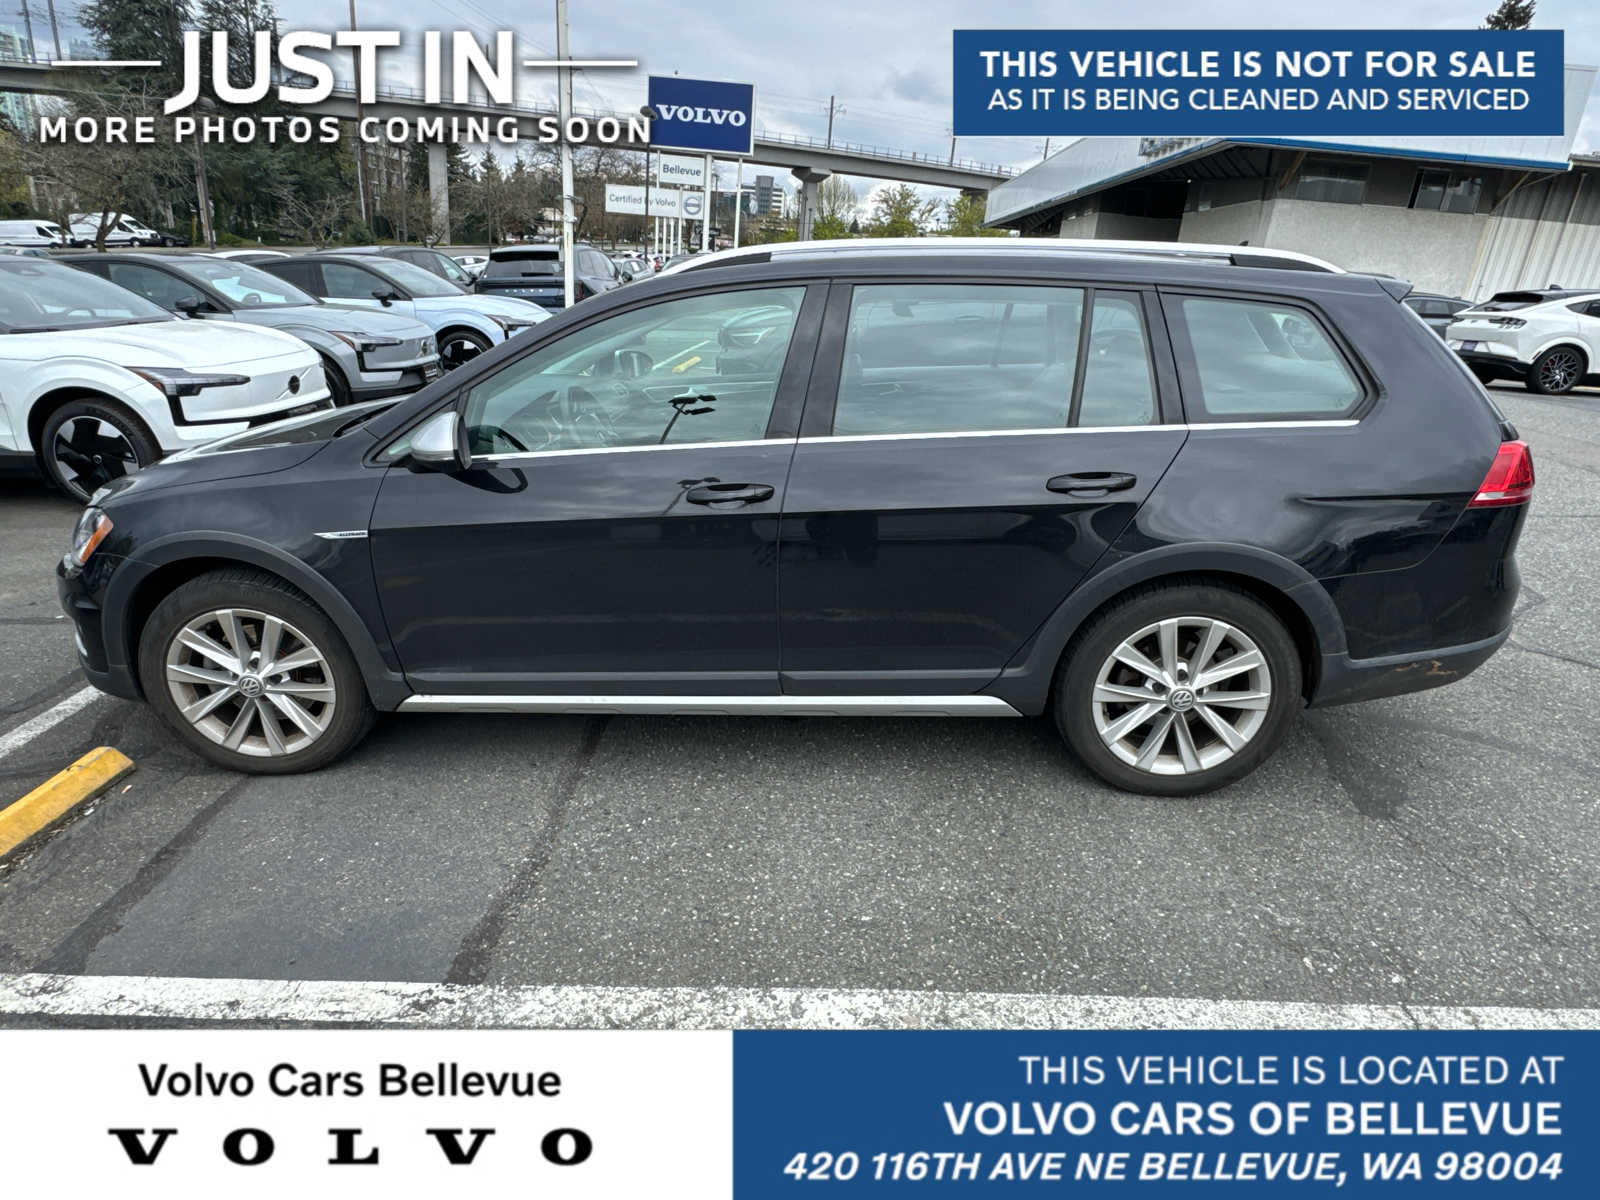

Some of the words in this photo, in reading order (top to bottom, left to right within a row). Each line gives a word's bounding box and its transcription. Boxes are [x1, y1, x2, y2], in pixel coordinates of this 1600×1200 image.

[656, 103, 746, 127] VOLVO
[662, 164, 702, 177] Bellevue
[656, 198, 676, 207] Volvo
